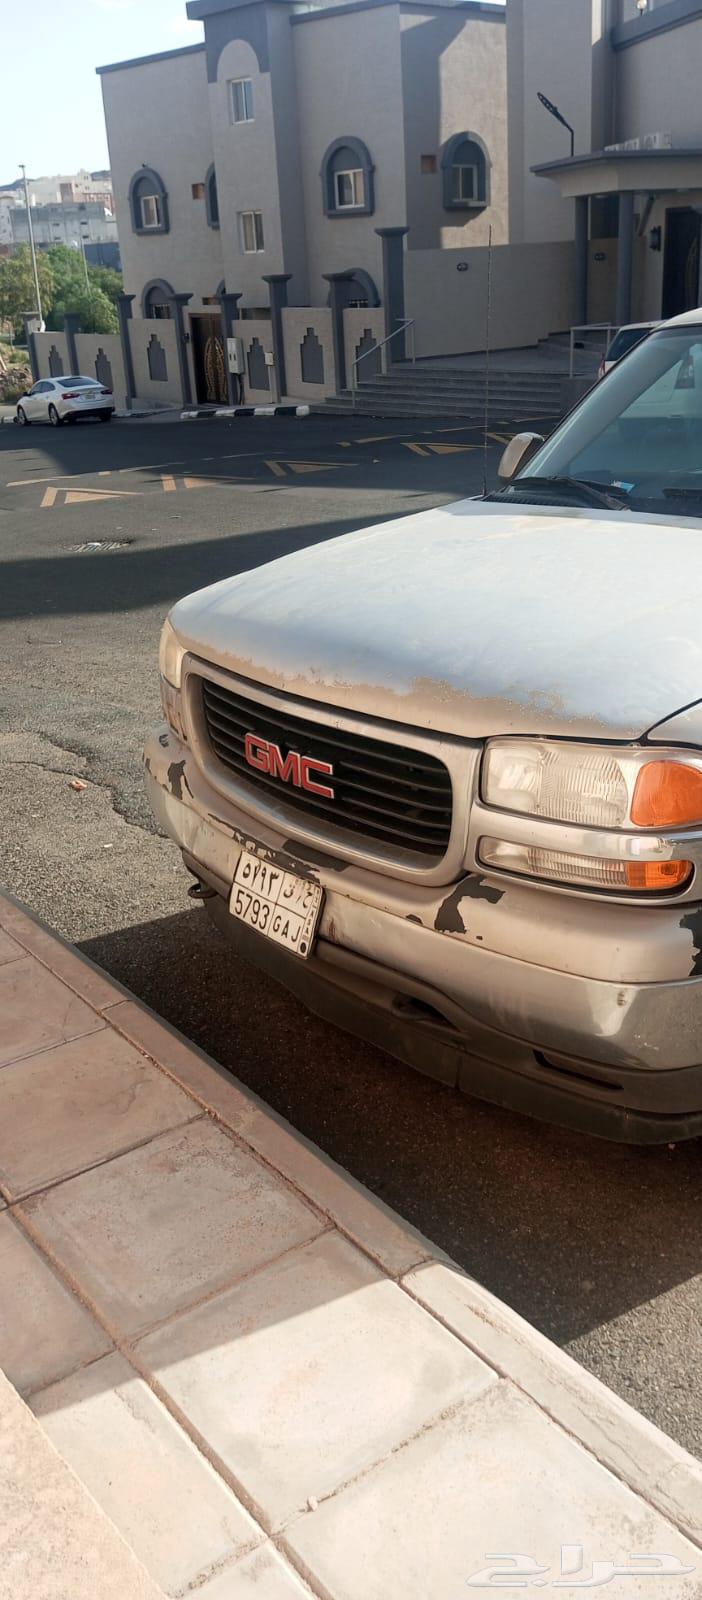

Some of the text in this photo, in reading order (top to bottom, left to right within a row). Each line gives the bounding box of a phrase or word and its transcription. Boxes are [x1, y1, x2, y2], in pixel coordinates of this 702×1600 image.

[244, 732, 334, 799] GMC
[242, 862, 280, 897] ٥٧٩٣
[234, 890, 270, 930] 5793
